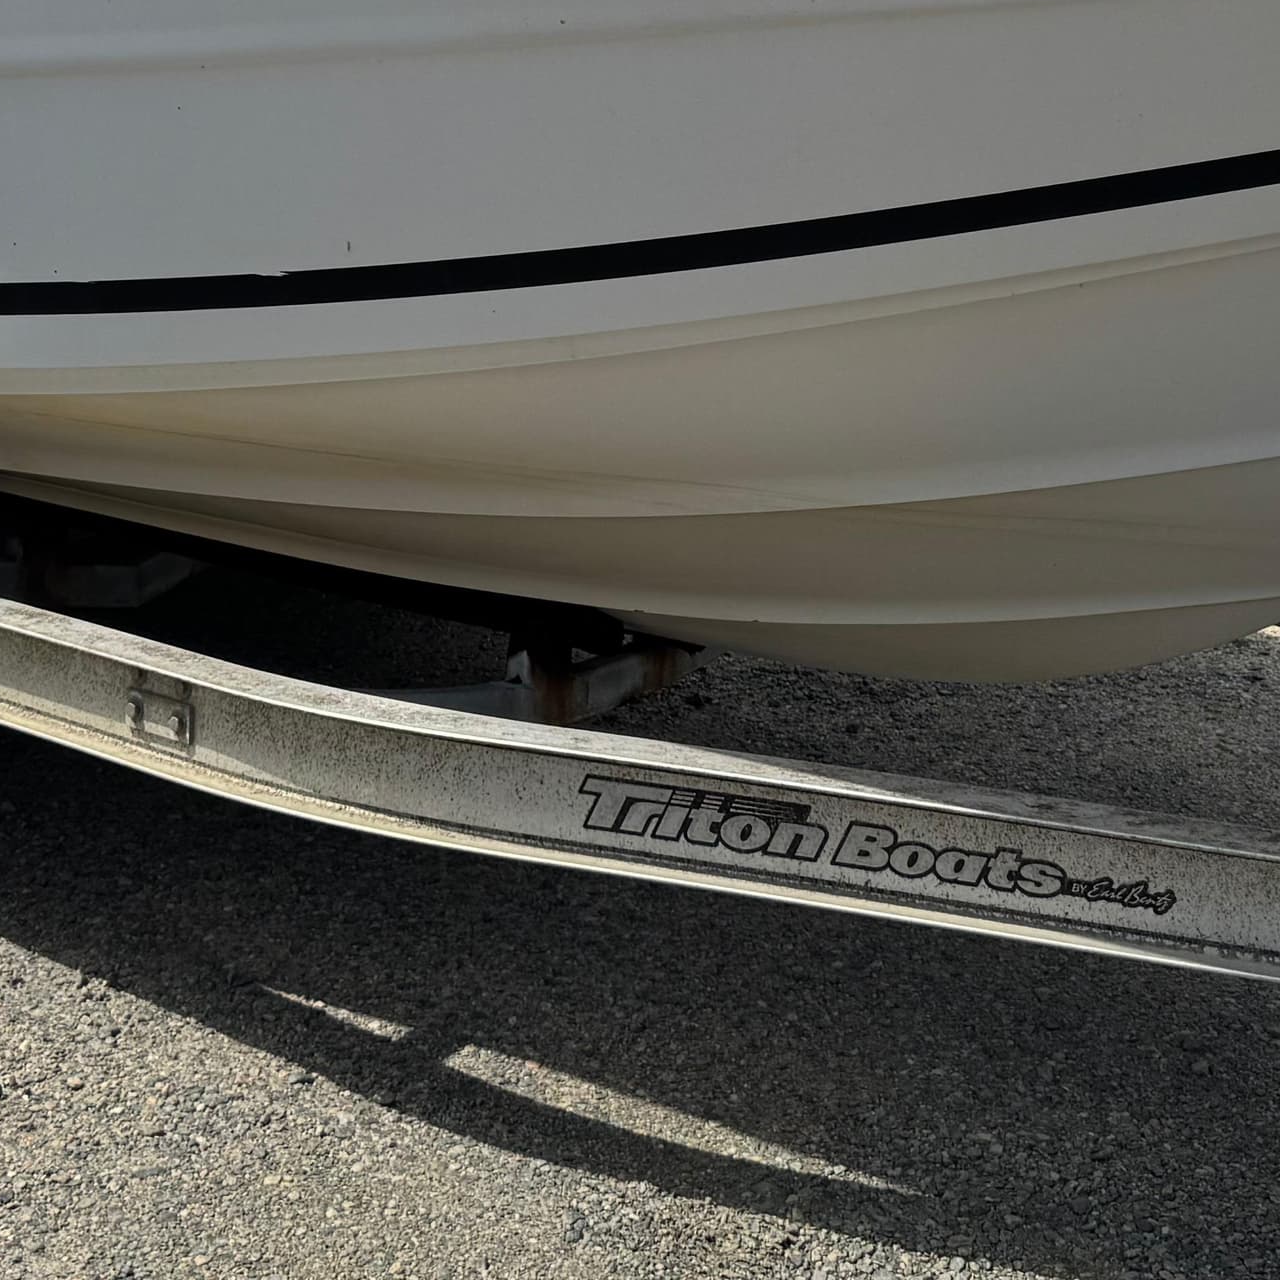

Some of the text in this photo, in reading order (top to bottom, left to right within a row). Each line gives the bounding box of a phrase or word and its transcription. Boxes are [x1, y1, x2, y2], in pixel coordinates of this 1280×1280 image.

[578, 773, 829, 862] Triton
[830, 821, 1067, 898] Boats
[1071, 883, 1087, 895] BY
